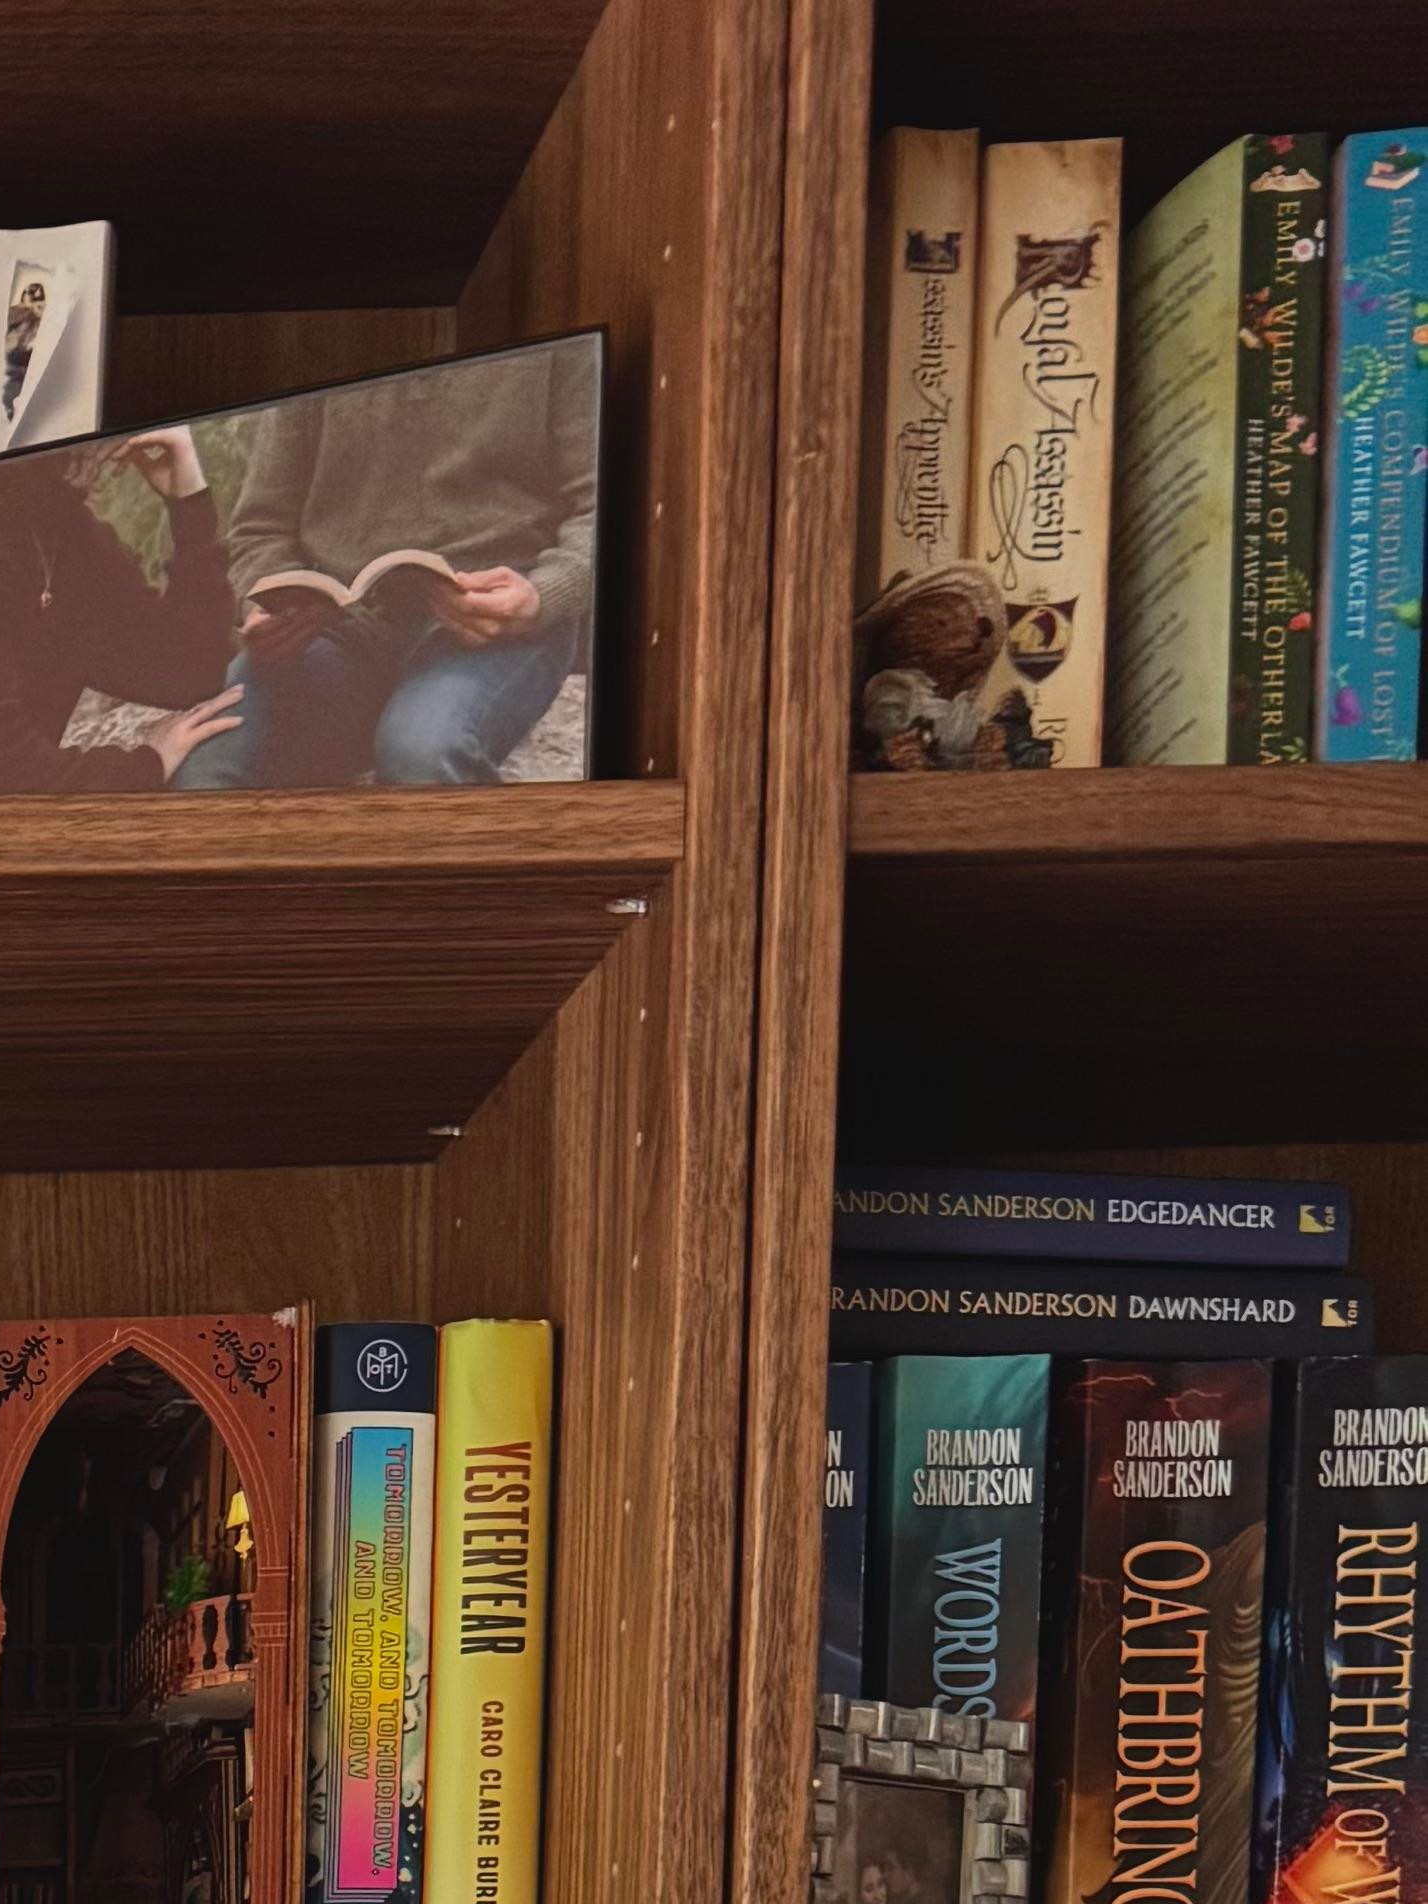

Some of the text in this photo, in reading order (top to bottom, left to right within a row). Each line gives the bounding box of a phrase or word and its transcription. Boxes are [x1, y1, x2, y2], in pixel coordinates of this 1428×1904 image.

[1346, 418, 1372, 640] HEATHER FAWCETT
[958, 1289, 1295, 1324] SANDERSON DAWNSHARD
[460, 1440, 531, 1656] YESTERYEAR
